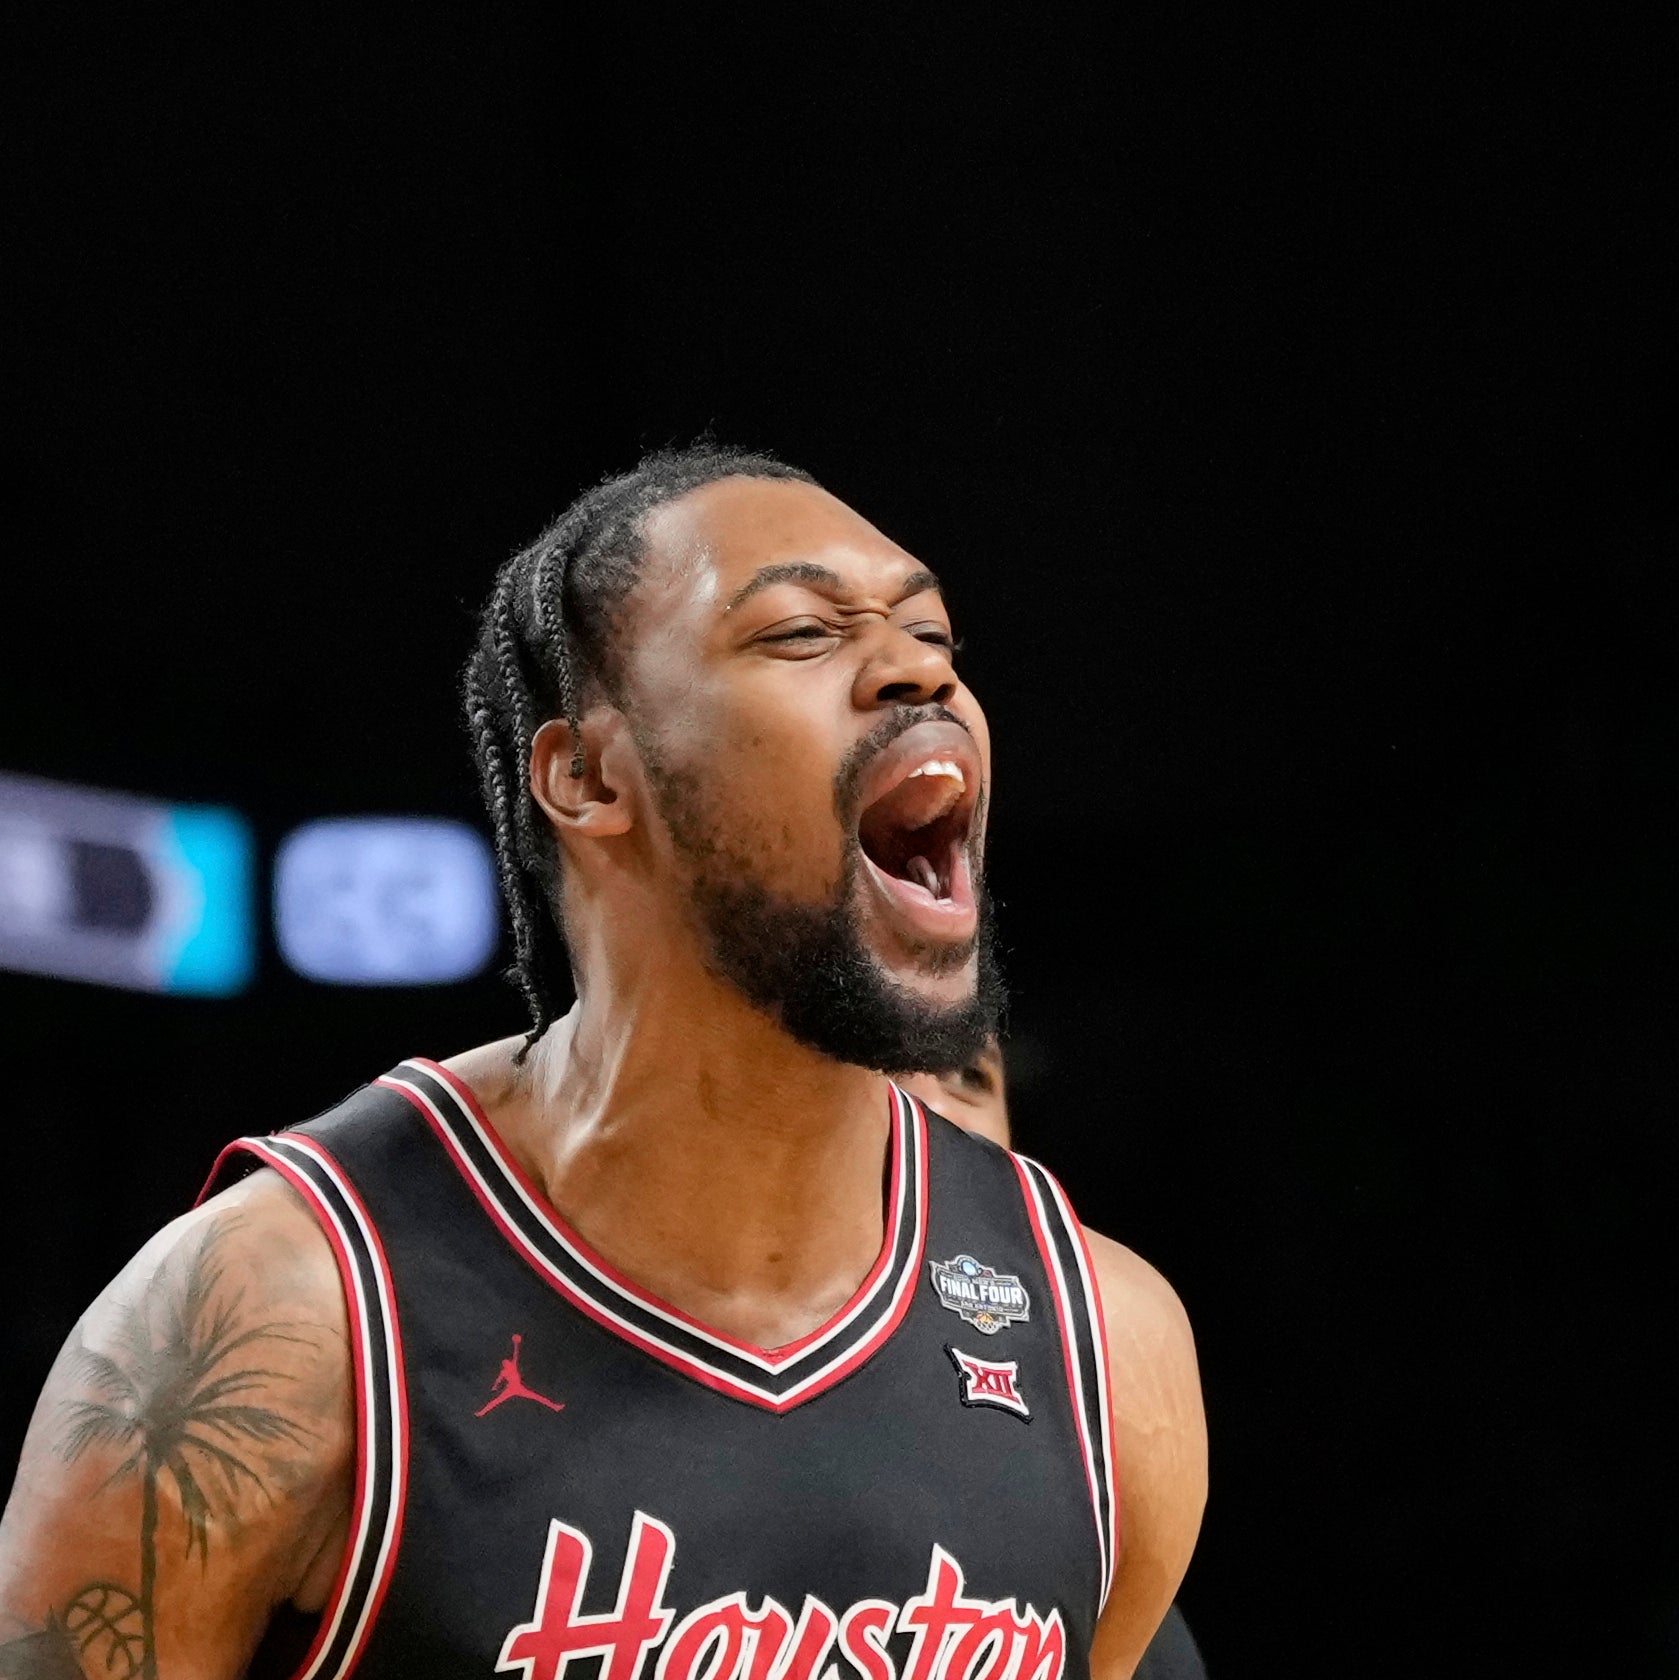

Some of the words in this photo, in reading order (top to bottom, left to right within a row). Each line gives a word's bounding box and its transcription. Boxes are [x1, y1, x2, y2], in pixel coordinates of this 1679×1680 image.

[940, 1275, 979, 1300] FINAL
[980, 1285, 1023, 1305] FOUR
[962, 1360, 1020, 1403] XII
